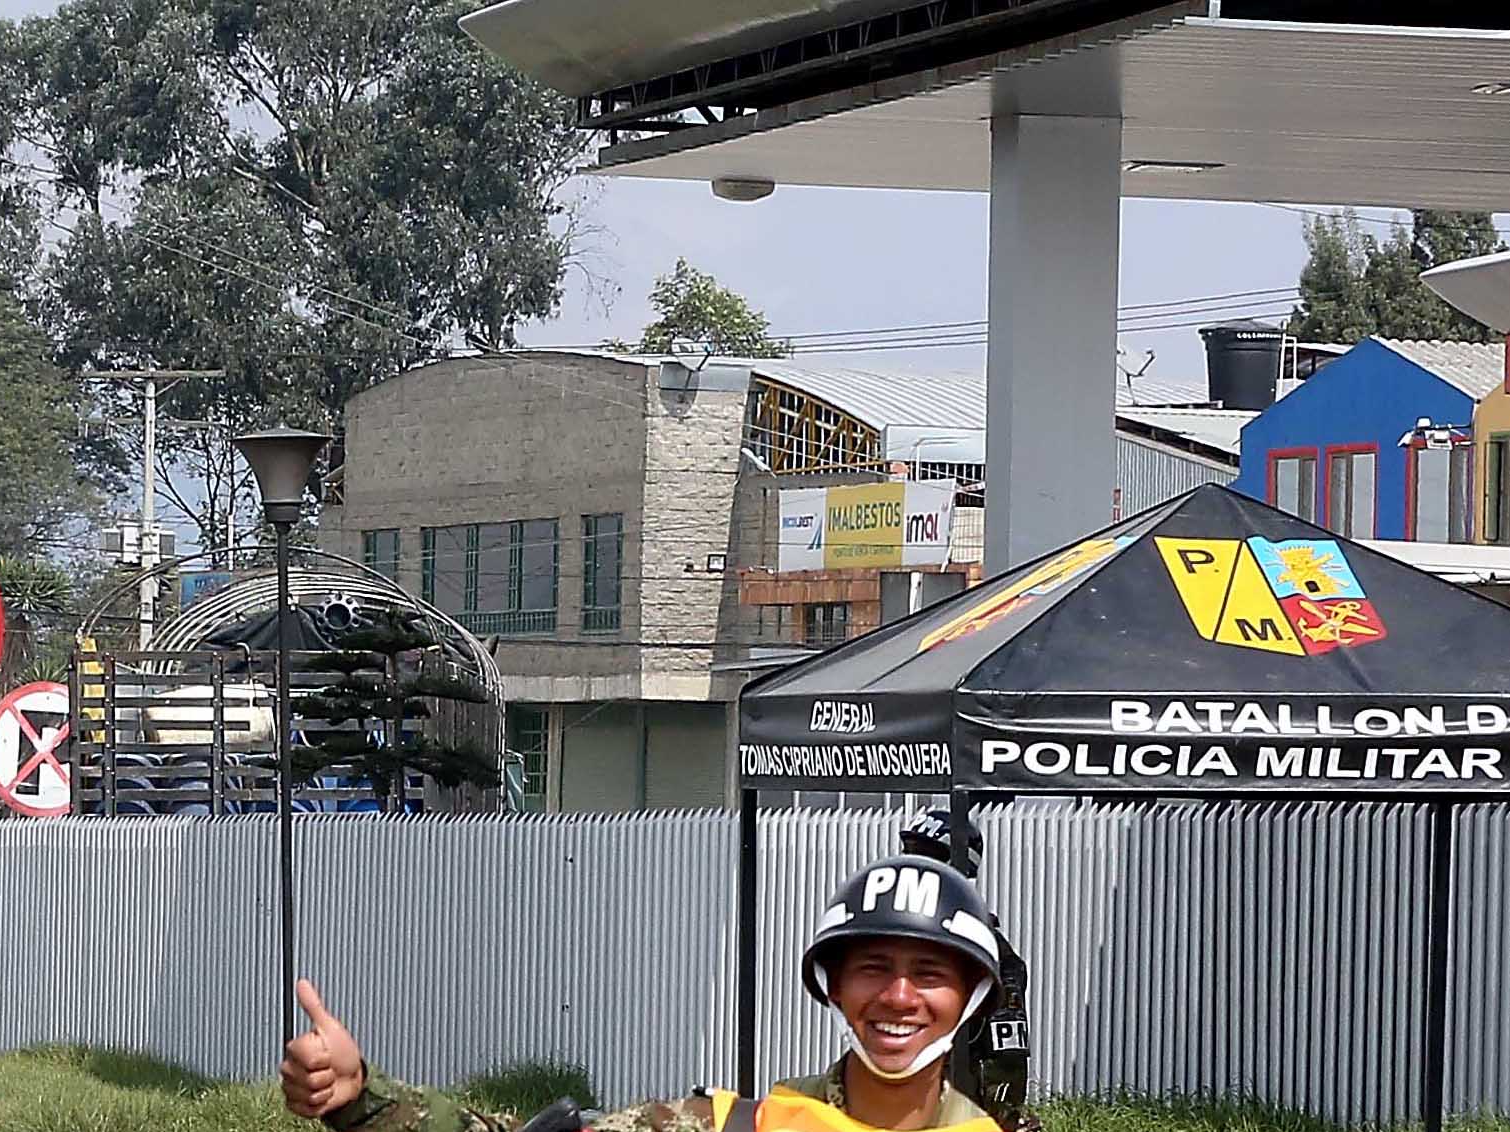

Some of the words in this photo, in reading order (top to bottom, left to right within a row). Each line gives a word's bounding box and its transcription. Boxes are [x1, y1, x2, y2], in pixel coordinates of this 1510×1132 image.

[828, 502, 901, 532] IMALBESTOS
[810, 701, 877, 732] GENERAL
[1111, 700, 1445, 736] BATALLON
[739, 745, 783, 776] TOMAS
[783, 745, 844, 777] CIPRIANO
[844, 746, 867, 776] DE
[866, 743, 952, 777] MOSQUERA
[981, 740, 1238, 777] POLICIA
[1255, 746, 1504, 780] MILITAR
[862, 867, 941, 918] PM
